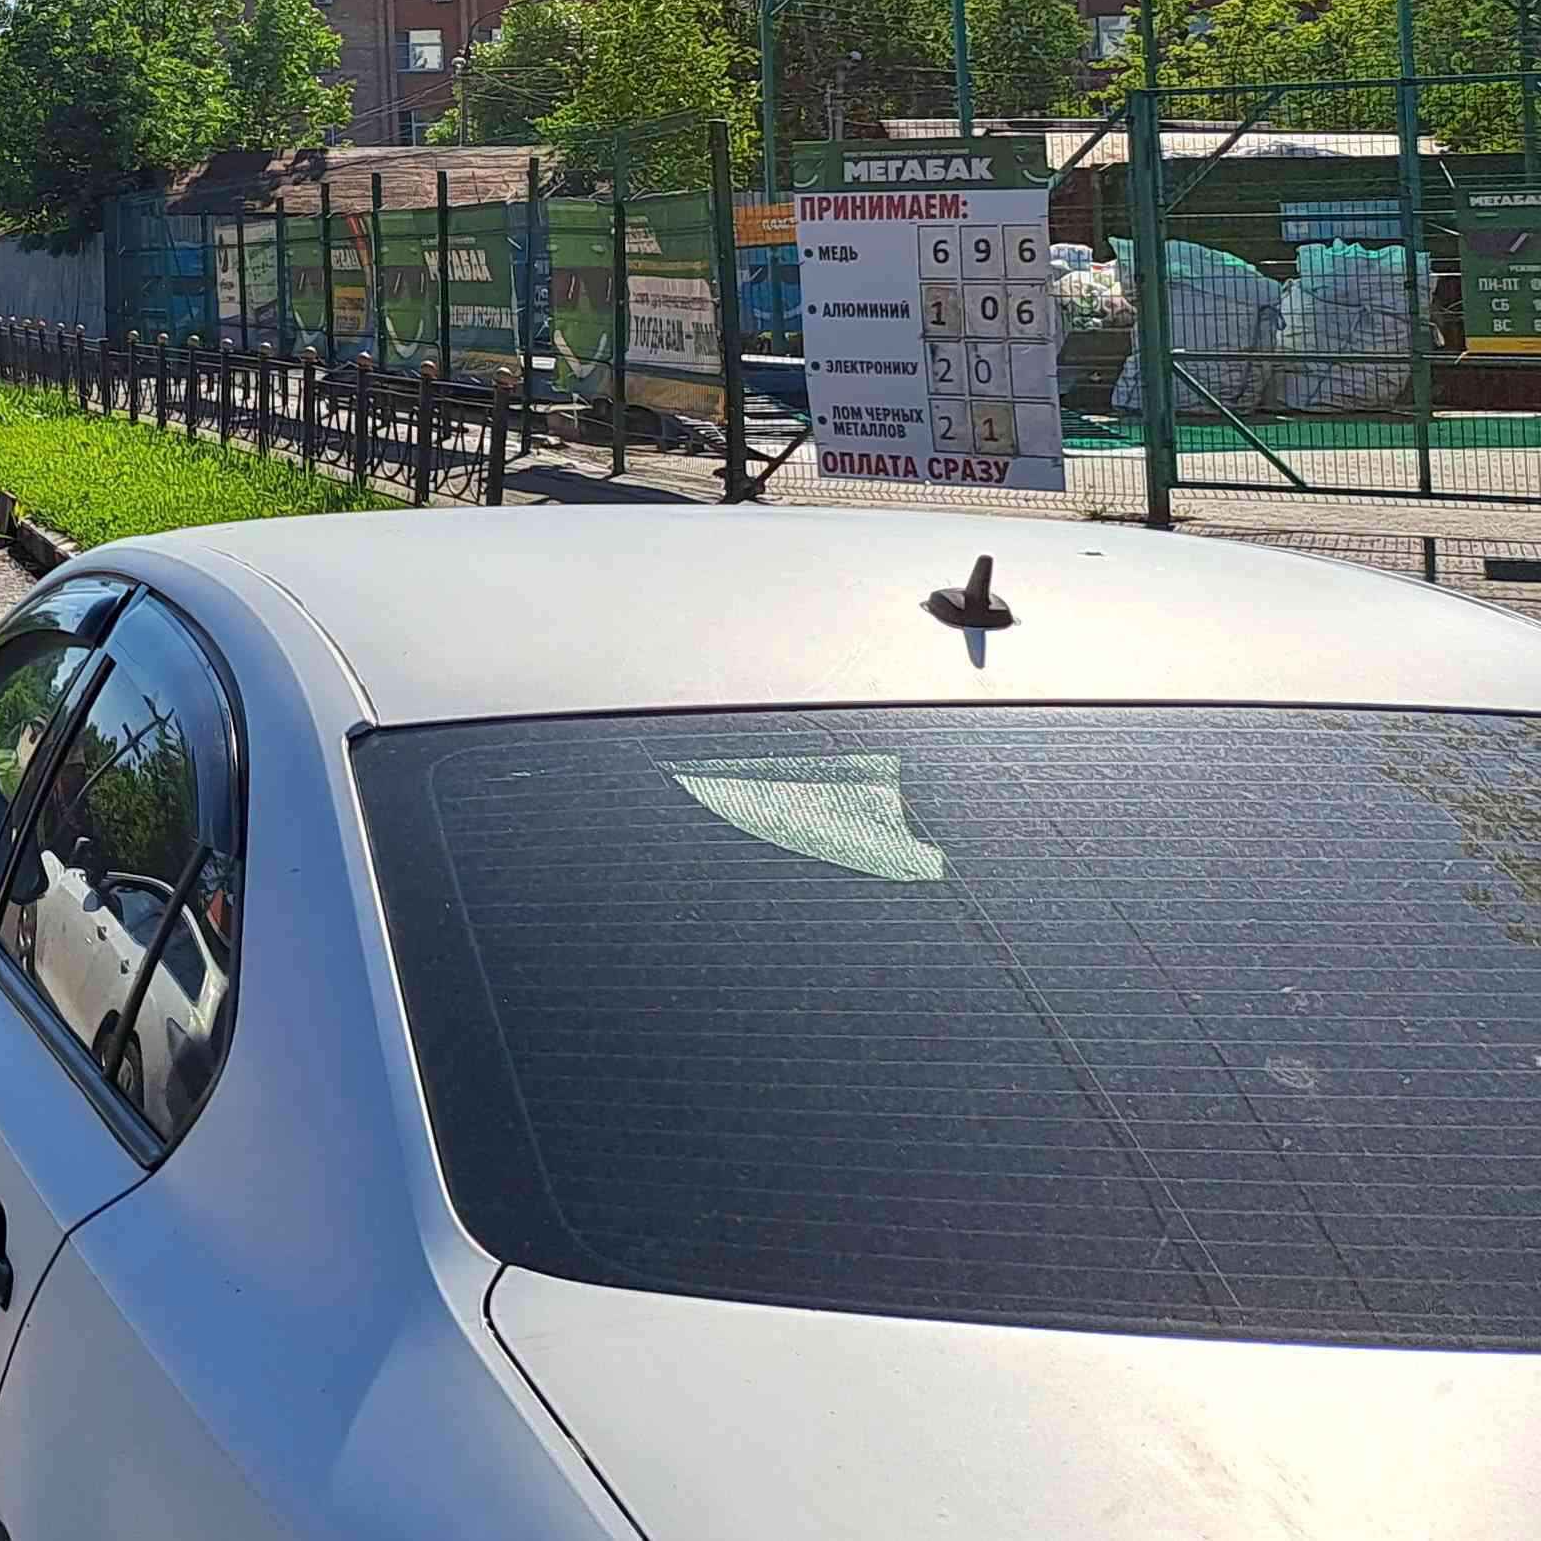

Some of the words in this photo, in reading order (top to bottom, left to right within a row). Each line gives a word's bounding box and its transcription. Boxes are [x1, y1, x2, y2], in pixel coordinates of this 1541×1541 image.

[843, 157, 995, 183] МЕГАБАК
[800, 194, 969, 222] ПРИНИМАЕМ:
[818, 245, 859, 263] МЕДЬ
[1478, 278, 1521, 291] ПН-ПТ
[822, 300, 910, 319] АЛЮМИНИЙ
[1491, 298, 1509, 311] СБ
[1493, 319, 1512, 331] ВС
[825, 360, 918, 376] ЭЛЕКТРОНИКУ
[832, 405, 864, 421] ЛОМ
[865, 407, 925, 424] ЧЕРНЫХ
[833, 423, 907, 439] МЕТАЛЛОВ
[822, 450, 920, 479] ОПЛАТА
[928, 458, 1011, 484] СРАЗУ
